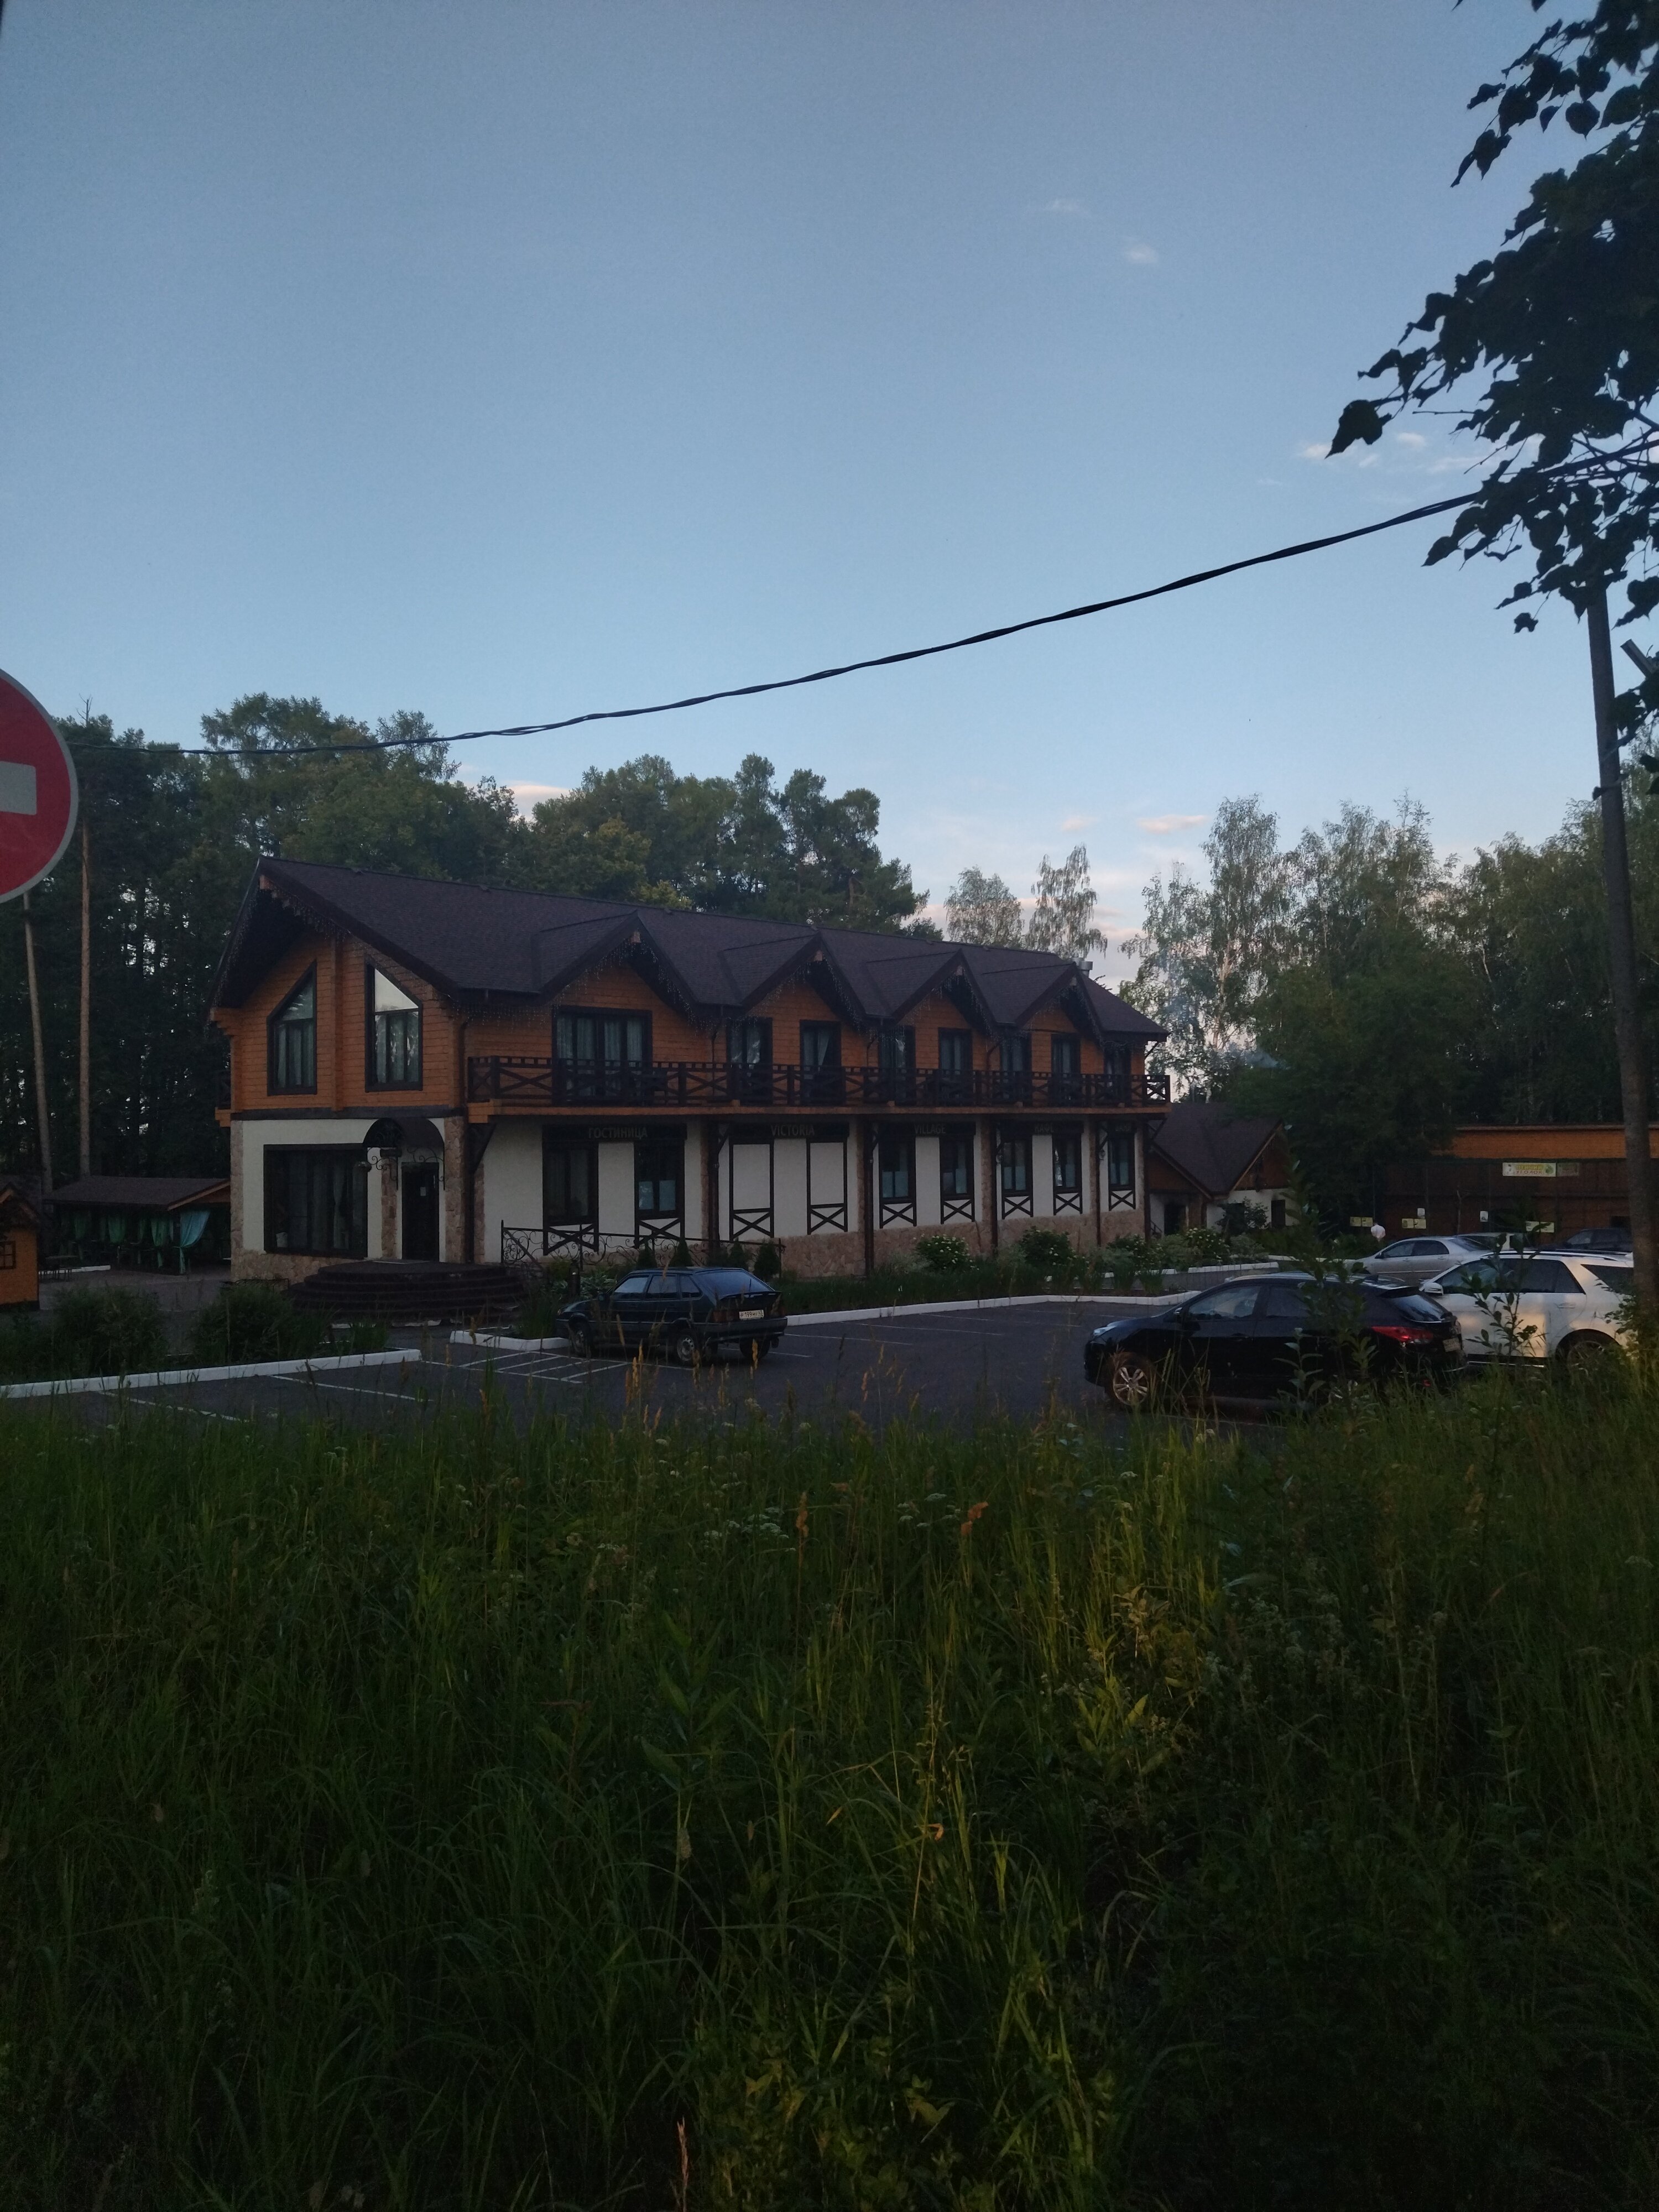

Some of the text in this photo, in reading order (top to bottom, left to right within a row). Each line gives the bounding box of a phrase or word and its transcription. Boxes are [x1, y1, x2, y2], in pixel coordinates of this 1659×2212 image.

[588, 1127, 648, 1139] ГОСТИНИЦА
[770, 1124, 814, 1136] VICTORIA
[914, 1123, 946, 1134] VILLAGE
